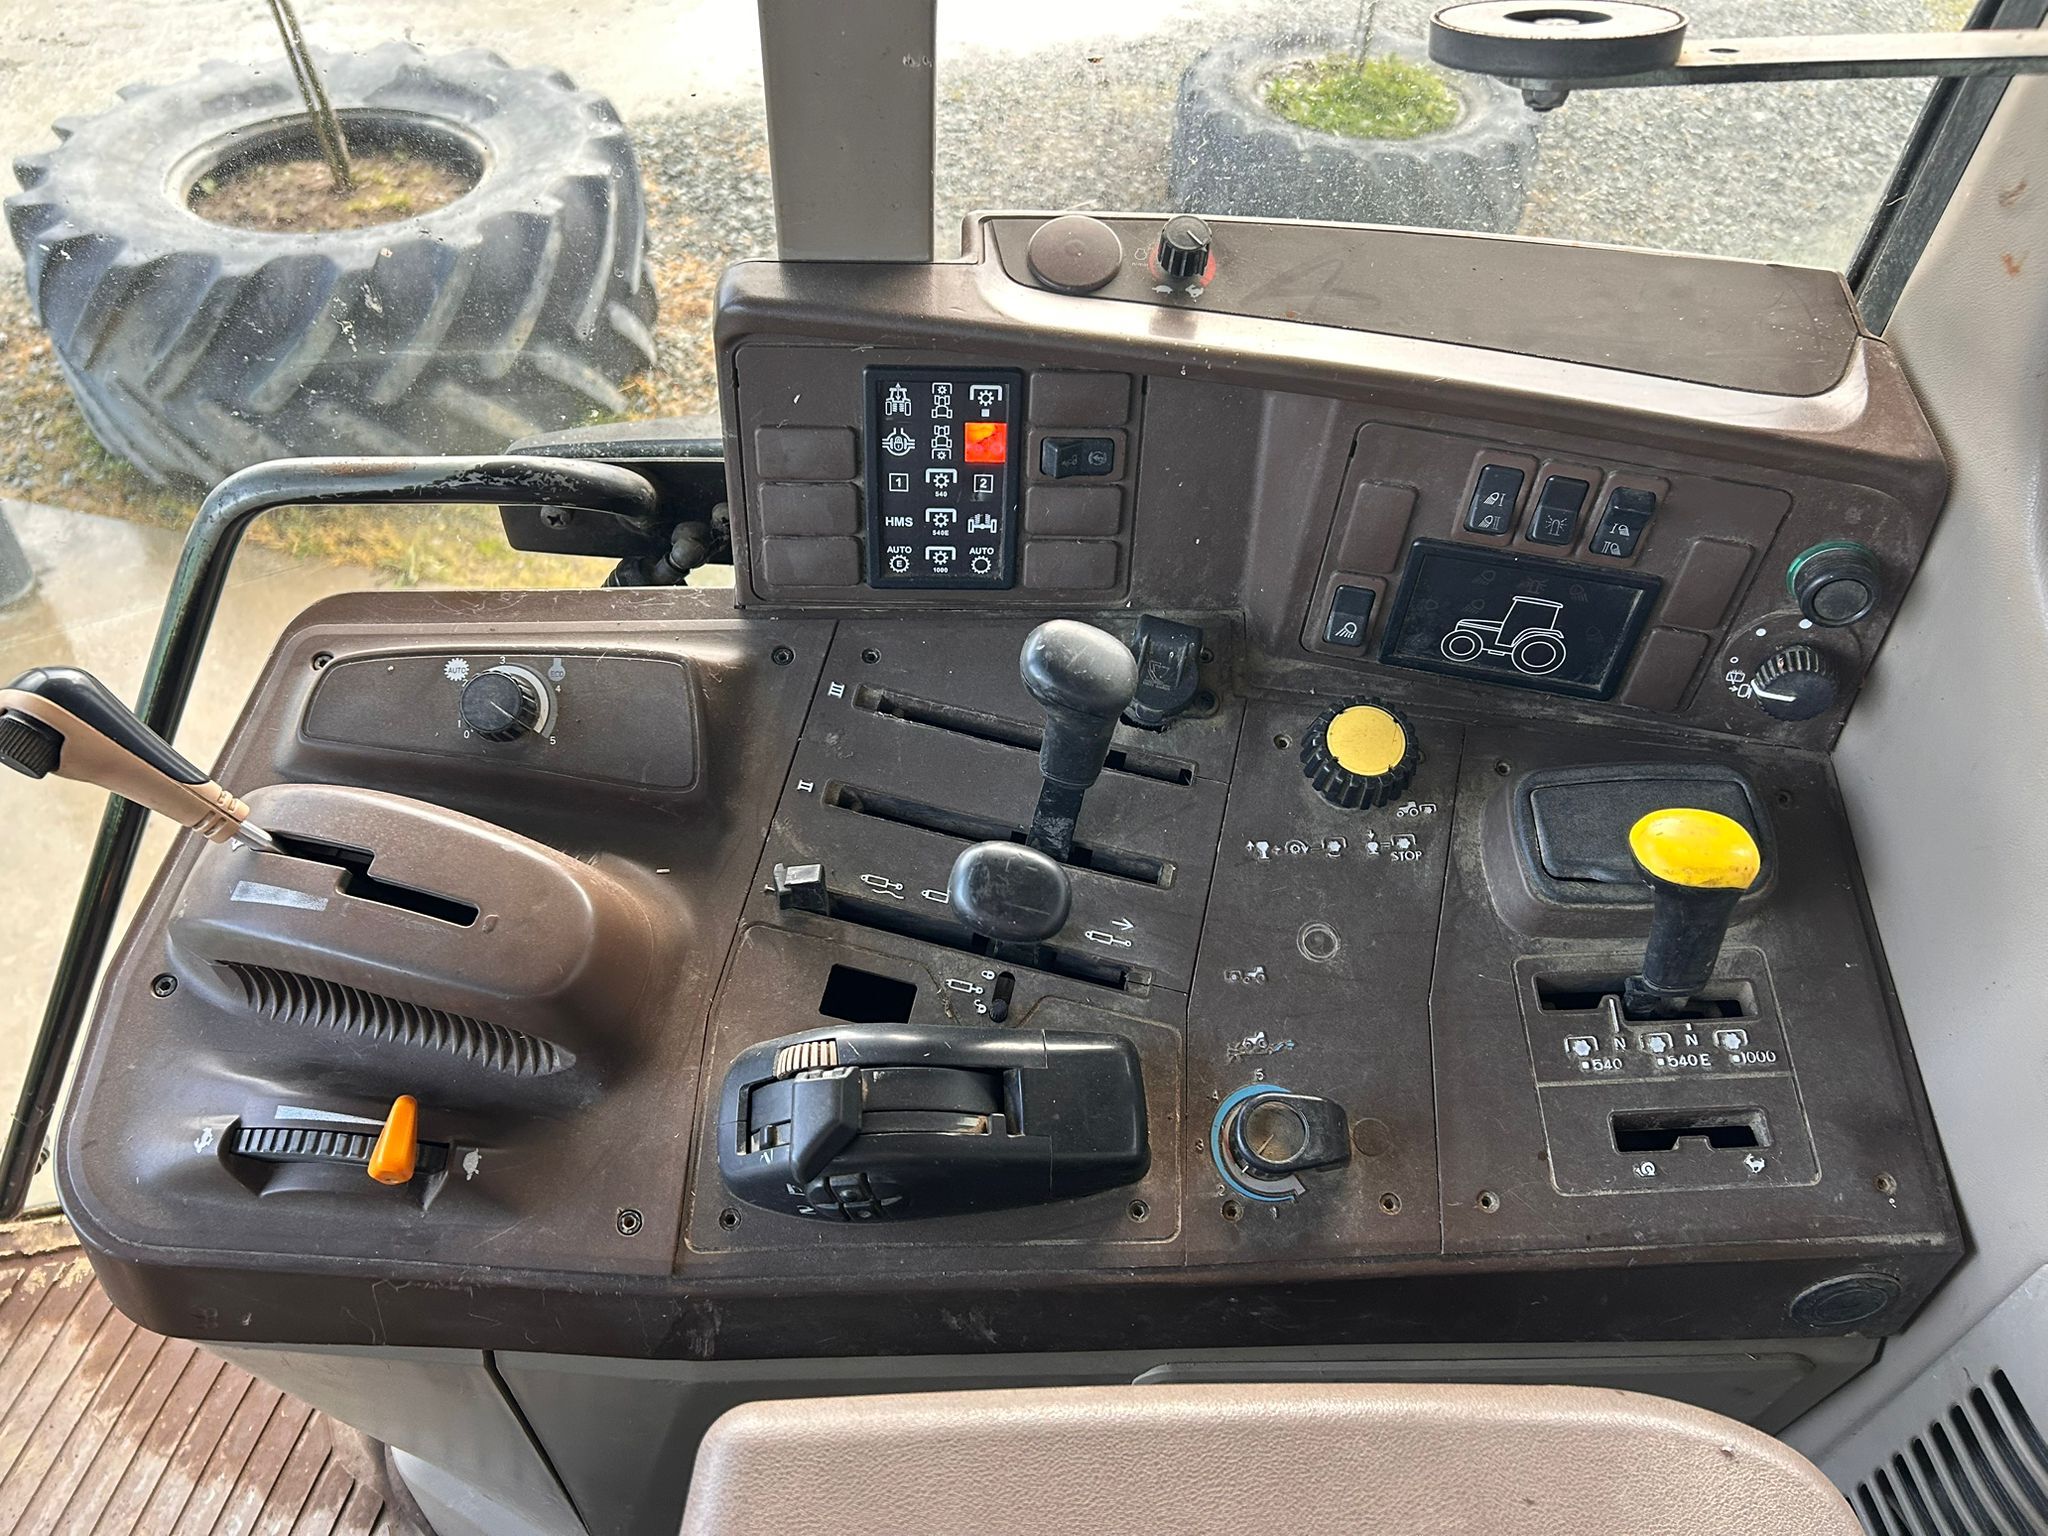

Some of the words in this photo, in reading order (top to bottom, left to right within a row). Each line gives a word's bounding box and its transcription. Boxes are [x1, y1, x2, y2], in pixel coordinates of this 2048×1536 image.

[979, 478, 988, 489] 2
[884, 516, 914, 527] HMS
[886, 545, 913, 554] AUTO
[968, 547, 995, 555] AUTO
[549, 736, 556, 745] 5
[1391, 850, 1423, 862] STOP
[1614, 1037, 1627, 1051] N
[1686, 1034, 1699, 1047] N
[1742, 1051, 1777, 1064] 1000
[1592, 1058, 1623, 1071] 540
[1254, 1068, 1264, 1081] 5
